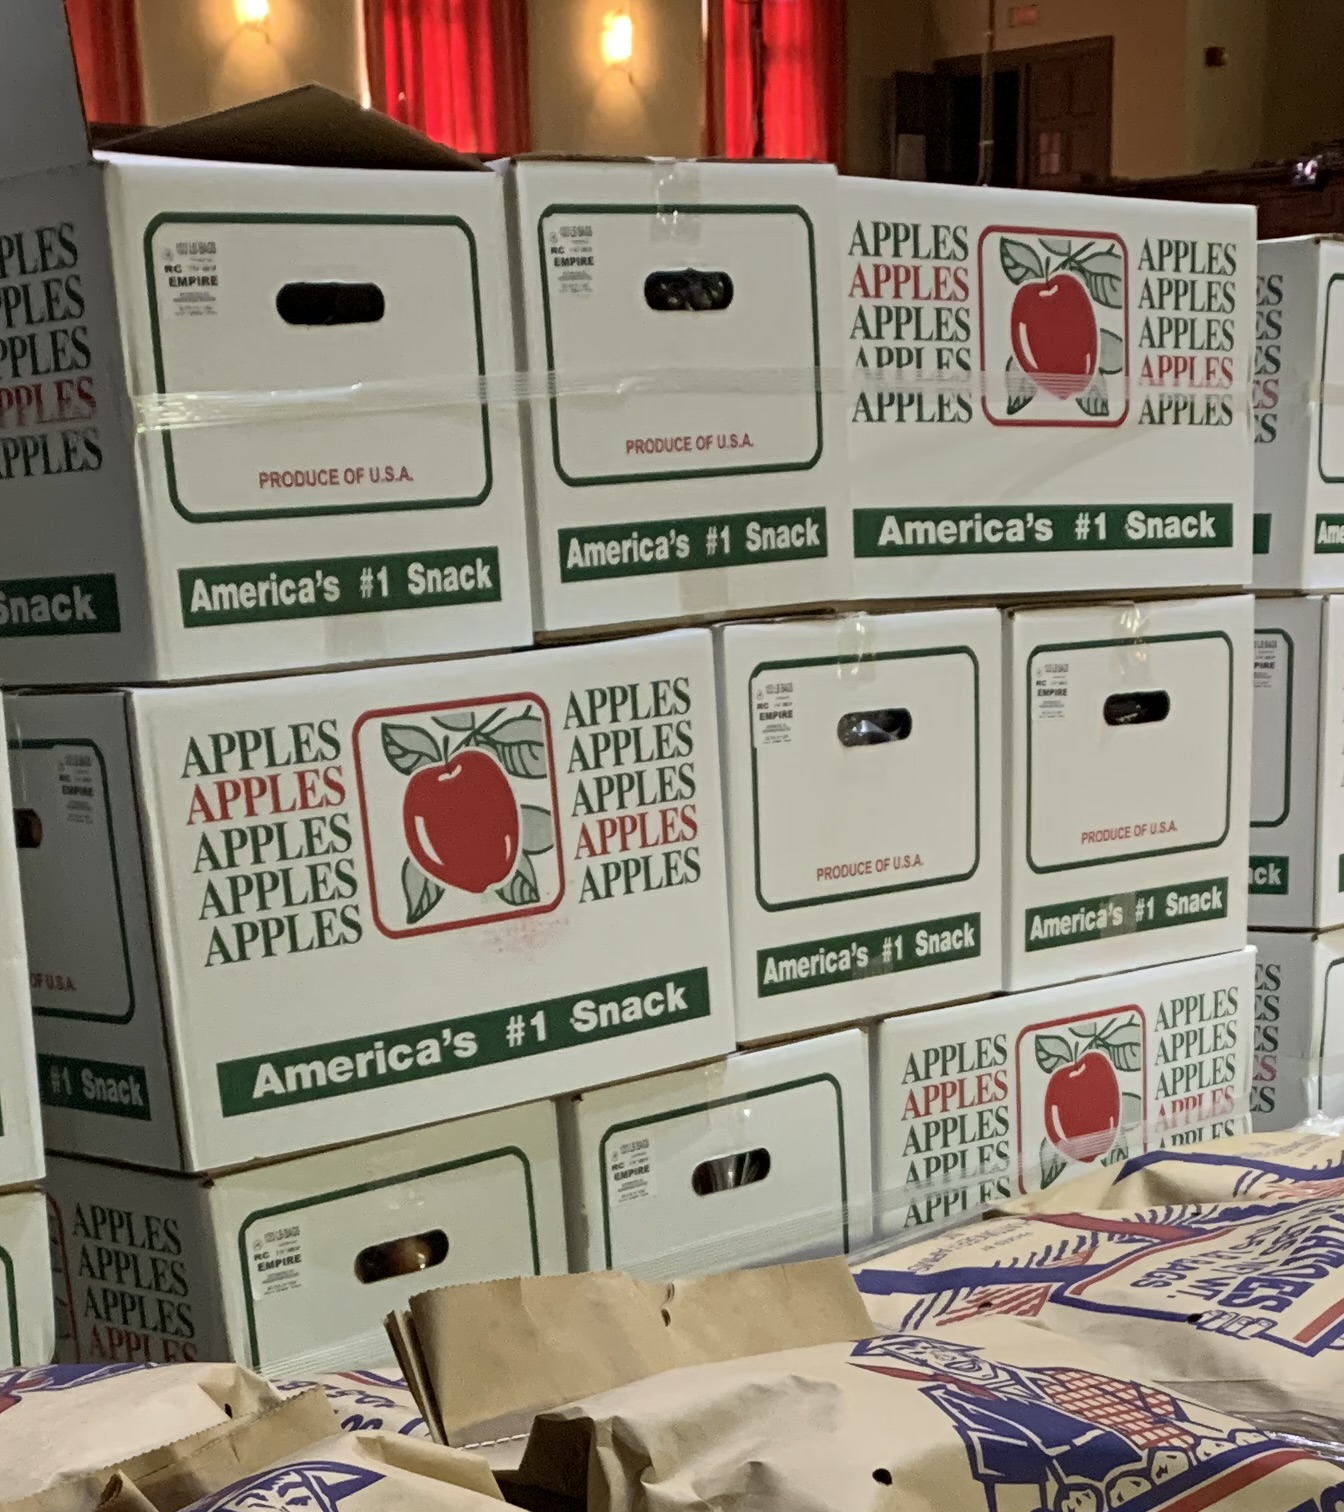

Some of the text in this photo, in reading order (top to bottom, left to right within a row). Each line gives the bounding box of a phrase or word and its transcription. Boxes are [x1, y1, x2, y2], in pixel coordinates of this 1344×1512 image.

[554, 256, 595, 268] EMPIRE
[848, 220, 969, 262] APPLES
[1137, 238, 1237, 276] APPLES
[168, 275, 219, 288] EMPIRE
[849, 264, 970, 302] APPLES
[1137, 277, 1237, 314] APPLES
[625, 433, 755, 456] PRODUCE OF U.S.A.
[258, 466, 414, 489] PRODUCE OF U.S.A.
[566, 517, 820, 571] America's #1 Snack
[877, 509, 1217, 549] America's #1 Snack
[189, 558, 493, 614] America's #1 Snack
[562, 676, 692, 730] APPLES
[759, 710, 794, 721] EMPIRE
[180, 719, 342, 779] APPLES
[566, 719, 695, 774] APPLES
[185, 765, 347, 826] APPLES
[569, 762, 697, 818] APPLES
[192, 812, 354, 875] APPLES
[816, 854, 924, 882] PRODUCE OF U.S.A.
[763, 923, 976, 985] America's #1 Snack
[1154, 986, 1239, 1032] APPLES
[251, 980, 688, 1101] America's #1 Snack
[901, 1034, 1008, 1084] APPLES
[1154, 1019, 1238, 1065] APPLES
[82, 1066, 144, 1108] Snack
[901, 1070, 1008, 1121] APPLES
[72, 1201, 183, 1256] APPLES
[77, 1242, 189, 1298] APPLES
